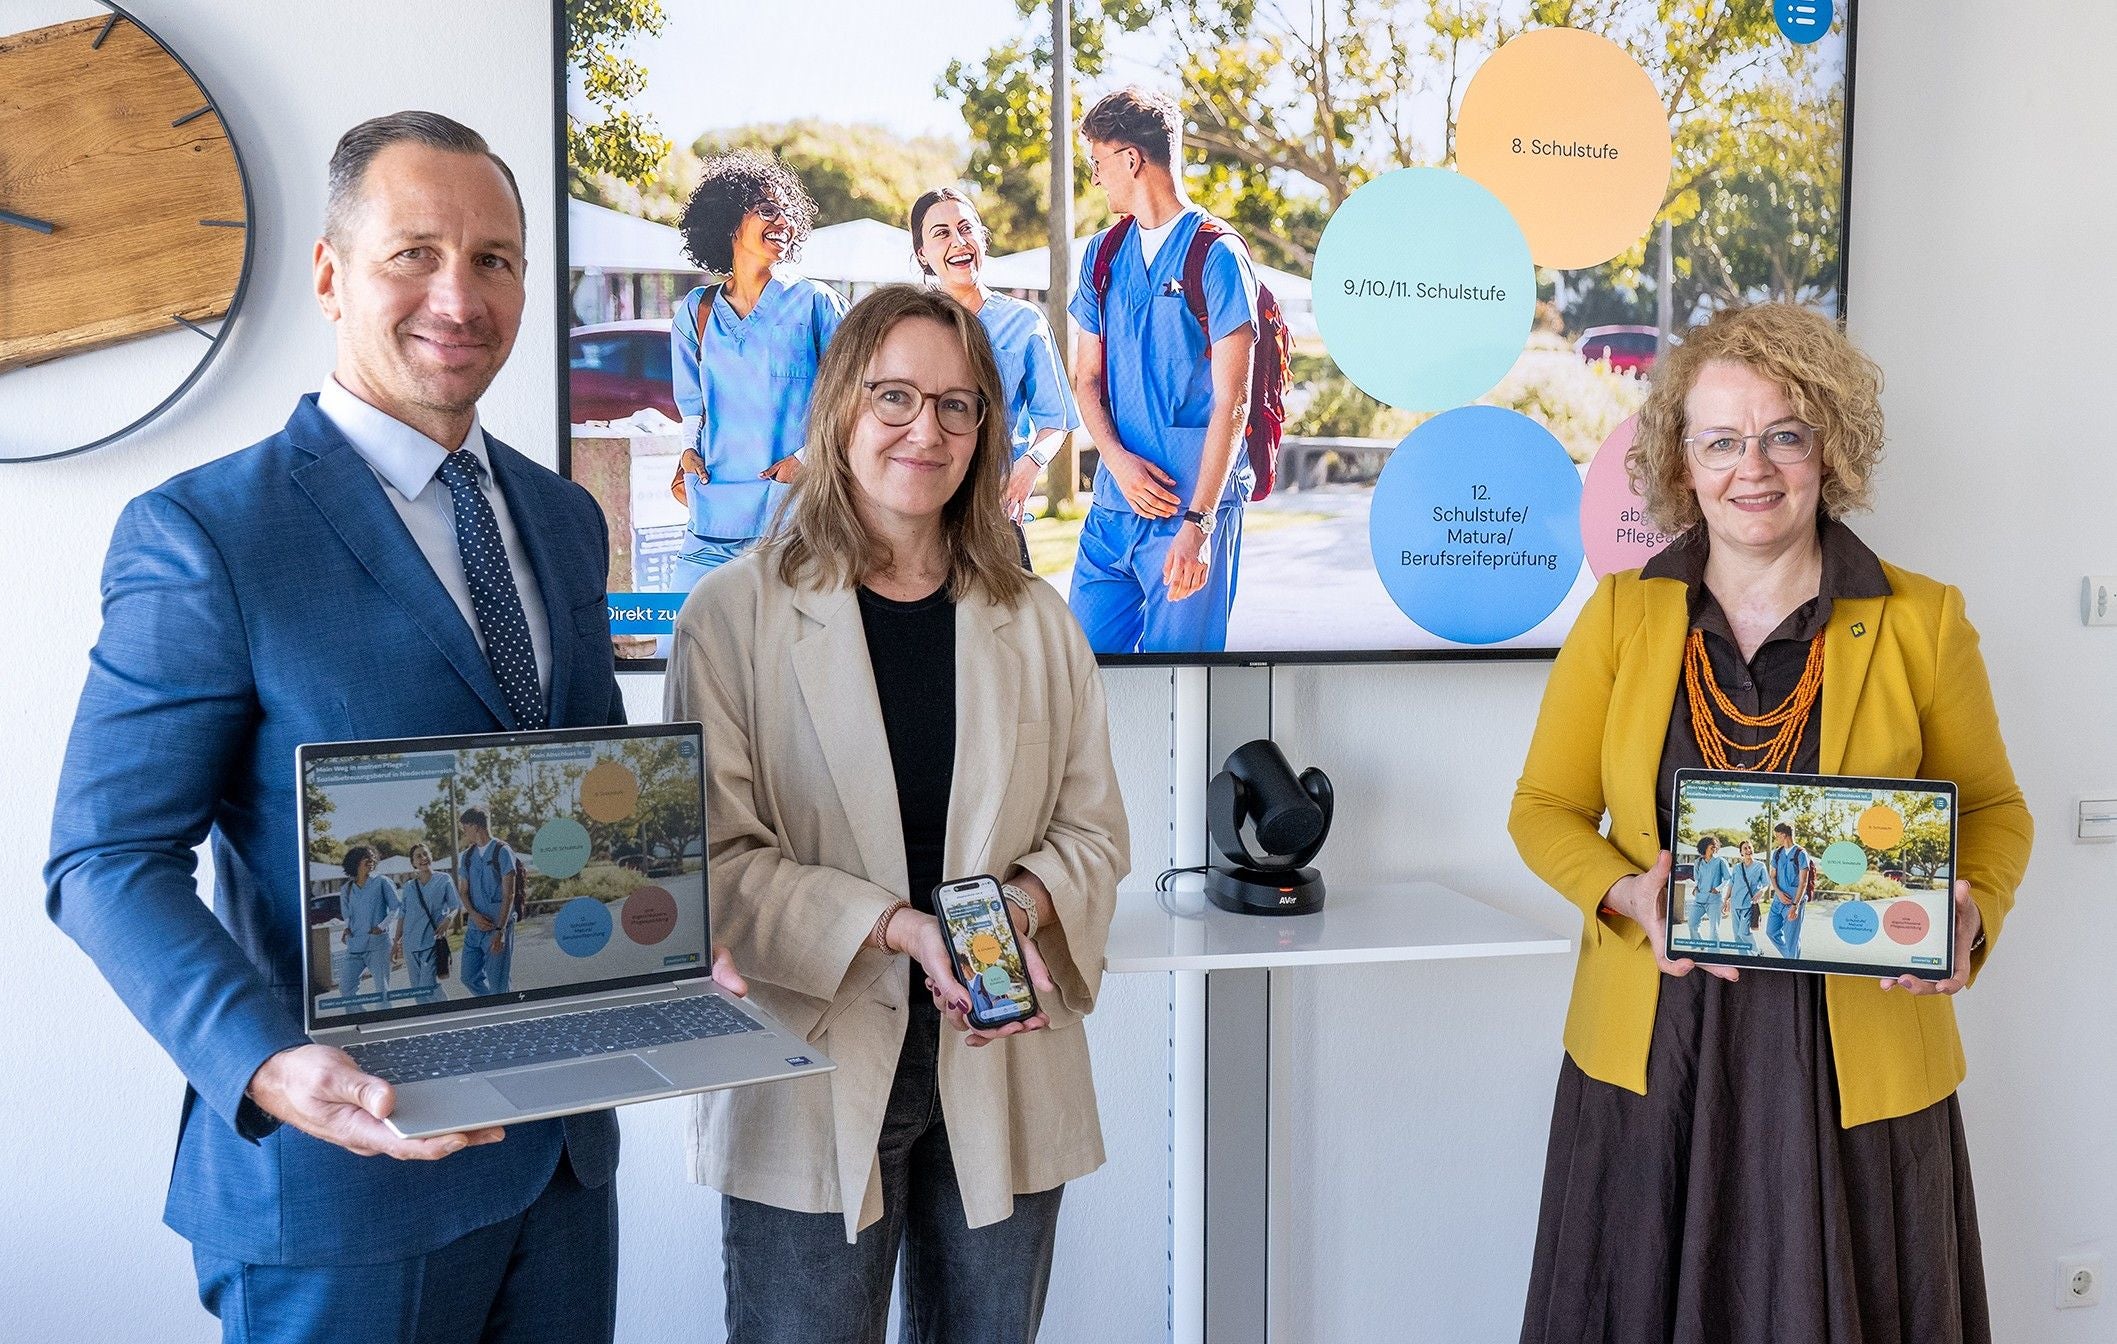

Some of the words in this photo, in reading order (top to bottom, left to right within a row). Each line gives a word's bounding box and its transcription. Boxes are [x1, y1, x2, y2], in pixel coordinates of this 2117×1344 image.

[1511, 138, 1526, 154] 8.
[1531, 139, 1619, 160] Schulstufe
[1343, 278, 1411, 300] 9./10./11.
[1416, 282, 1506, 302] Schulstufe
[1471, 484, 1491, 501] 12.
[1432, 505, 1529, 525] Schulstufe/
[1447, 527, 1514, 546] Matura/
[1616, 529, 1674, 548] Pflegea
[1401, 549, 1558, 570] Berufsreifeprüfung
[658, 610, 677, 621] zu
